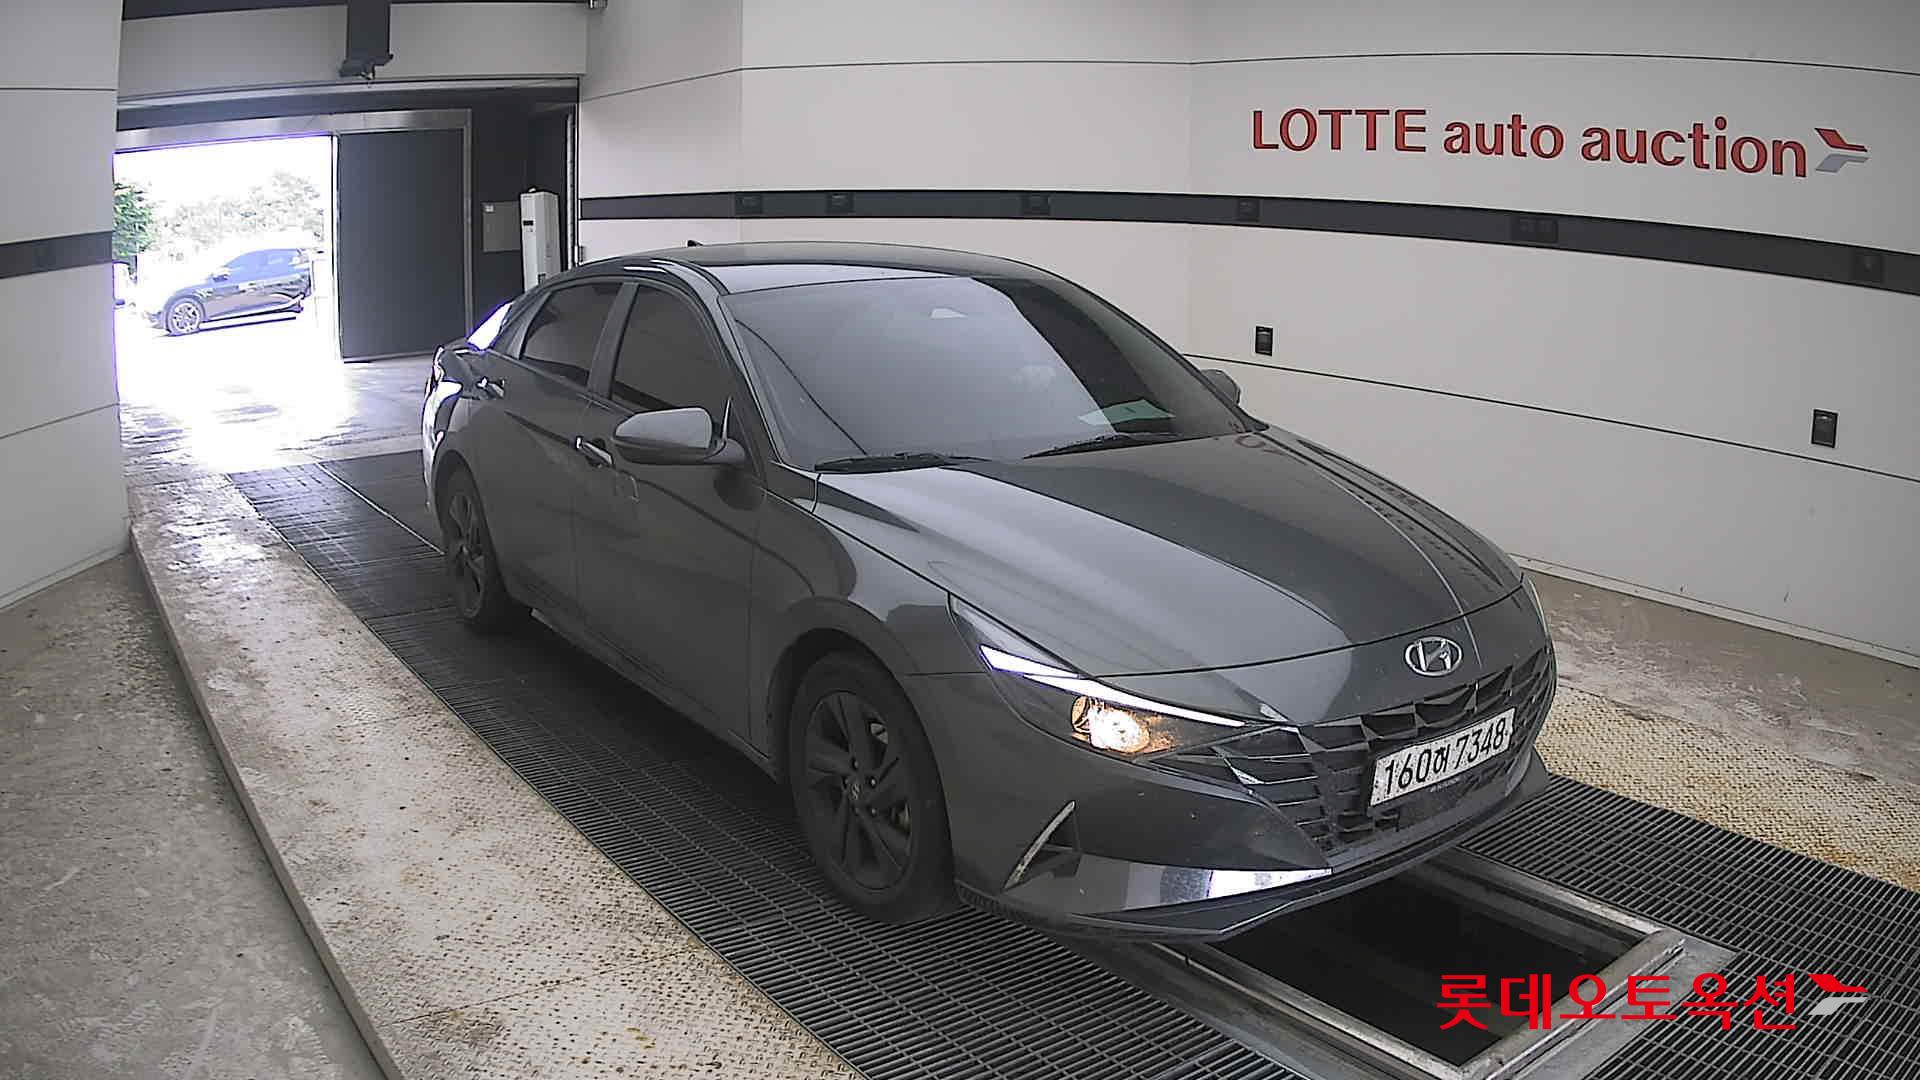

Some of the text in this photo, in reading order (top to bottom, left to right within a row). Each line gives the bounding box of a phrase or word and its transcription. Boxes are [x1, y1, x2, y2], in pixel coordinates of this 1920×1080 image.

[1252, 108, 1807, 178] LOTTE auto auction
[1454, 717, 1507, 770] 7348
